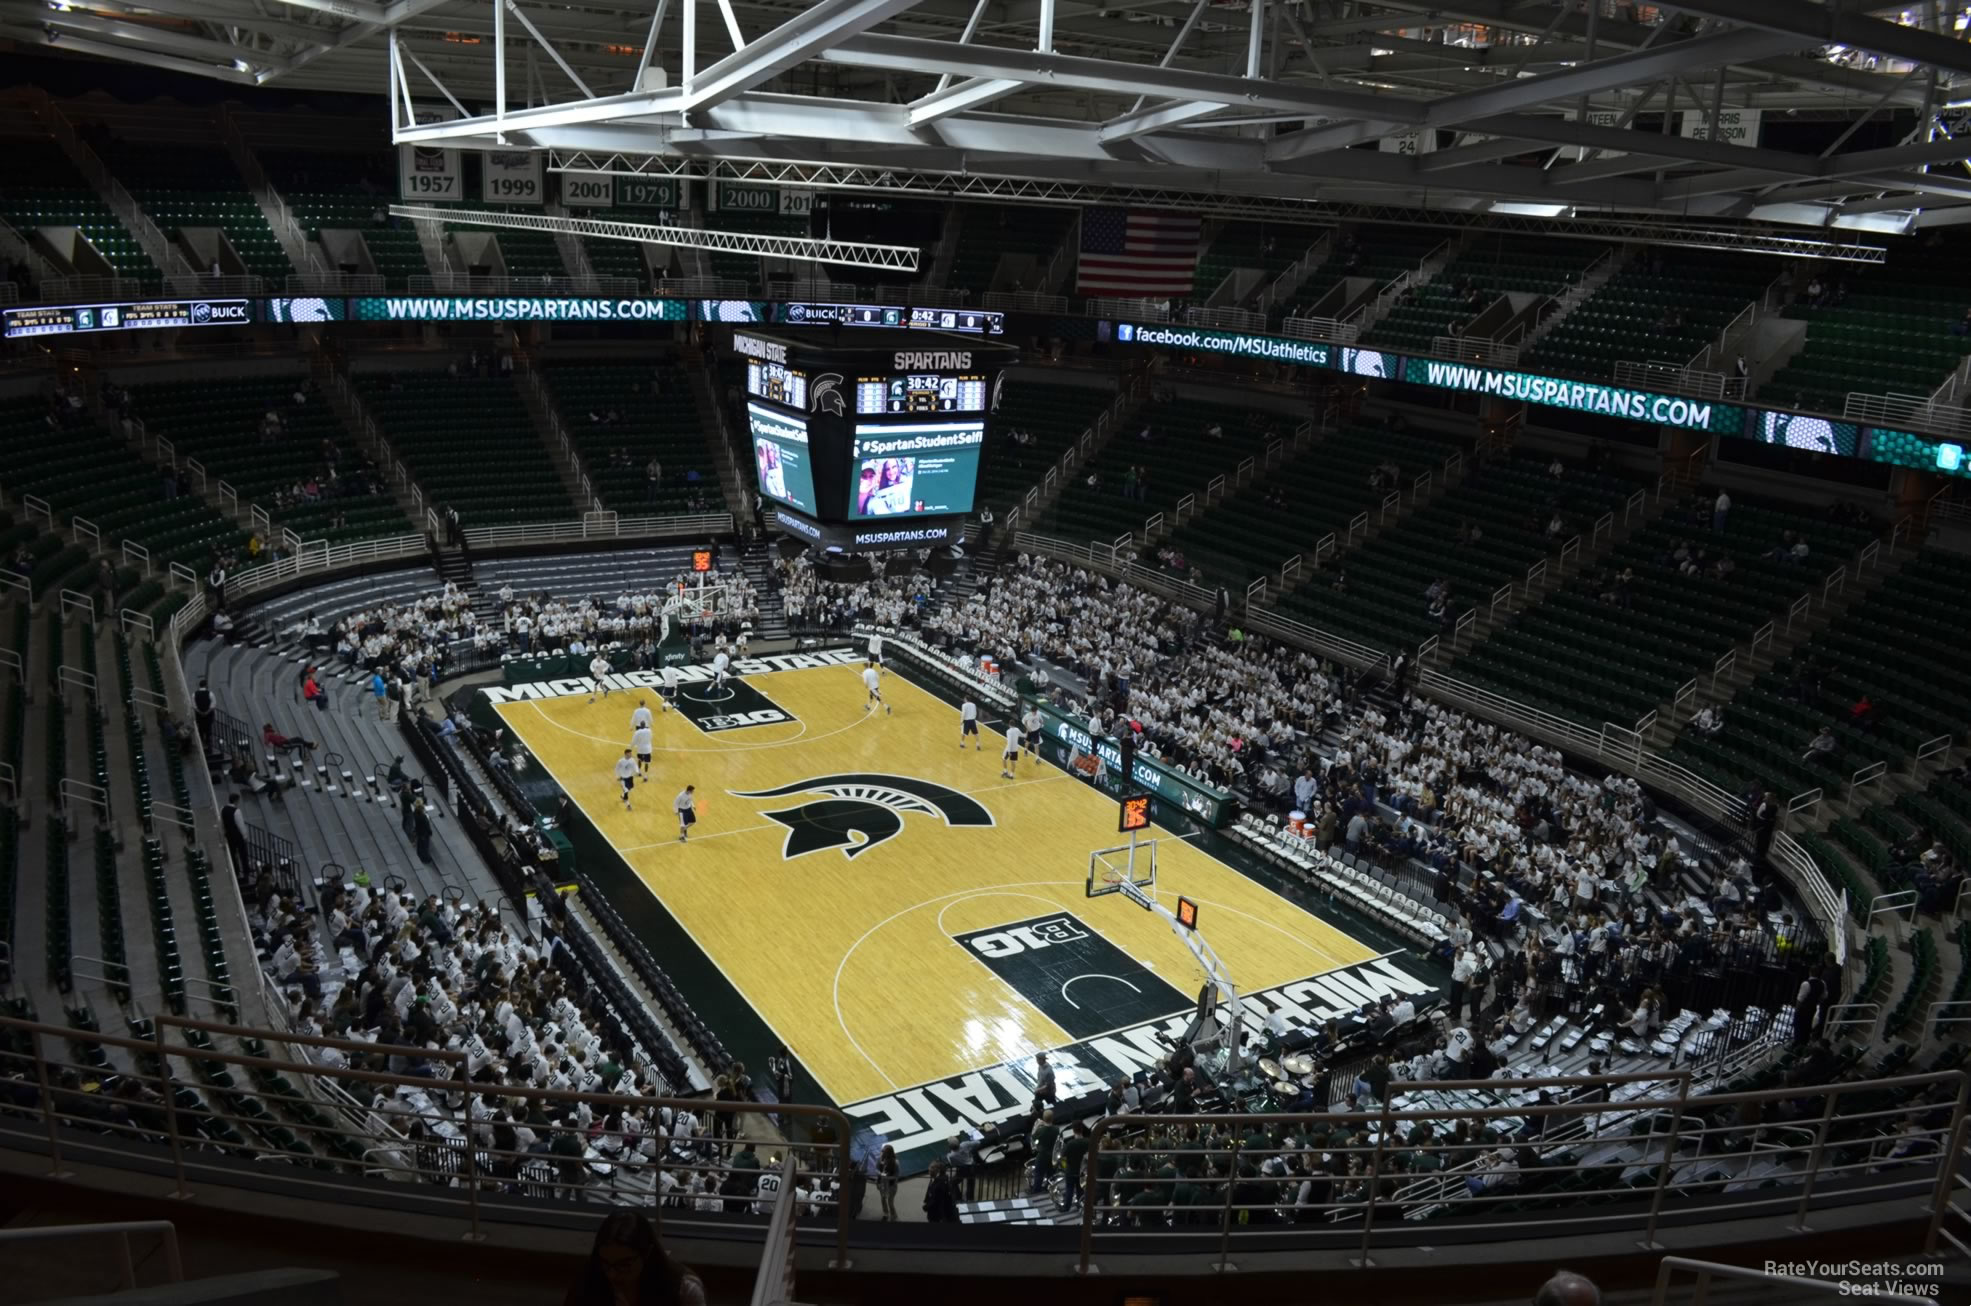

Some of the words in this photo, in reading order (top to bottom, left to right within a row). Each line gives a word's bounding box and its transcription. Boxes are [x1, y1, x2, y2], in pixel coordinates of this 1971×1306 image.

[1399, 140, 1416, 154] 24
[409, 175, 454, 193] 1957
[490, 178, 536, 196] 1999
[569, 181, 610, 199] 2001
[624, 184, 670, 204] 1979
[727, 189, 770, 208] 2000
[211, 306, 245, 318] BUICK
[386, 299, 664, 318] WWW.MSUSPARTANS.COM
[805, 308, 835, 319] BUICK
[863, 310, 871, 322] 0
[967, 316, 975, 328] 0
[734, 334, 766, 360] MICHIGAN
[766, 342, 787, 364] STATE
[1136, 327, 1327, 364] facebook.com/MSUathletics
[894, 351, 972, 370] SPARTANS
[907, 377, 939, 389] 30:42
[1427, 362, 1711, 430] WWW.MSUSPARTANS.COM
[893, 401, 900, 411] 0
[944, 399, 951, 410] 0
[777, 512, 821, 540] MSUSPARTANS.COM
[855, 528, 948, 545] MSUSPARTANS.COM
[664, 652, 686, 662] xfinity
[477, 662, 728, 703] MICHIGAN
[735, 647, 868, 675] STATE
[1455, 1031, 1467, 1044] 20
[473, 1047, 484, 1058] 20
[582, 1073, 595, 1085] 20
[621, 1072, 632, 1084] 20
[678, 1115, 689, 1126] 20
[762, 1178, 779, 1192] 20
